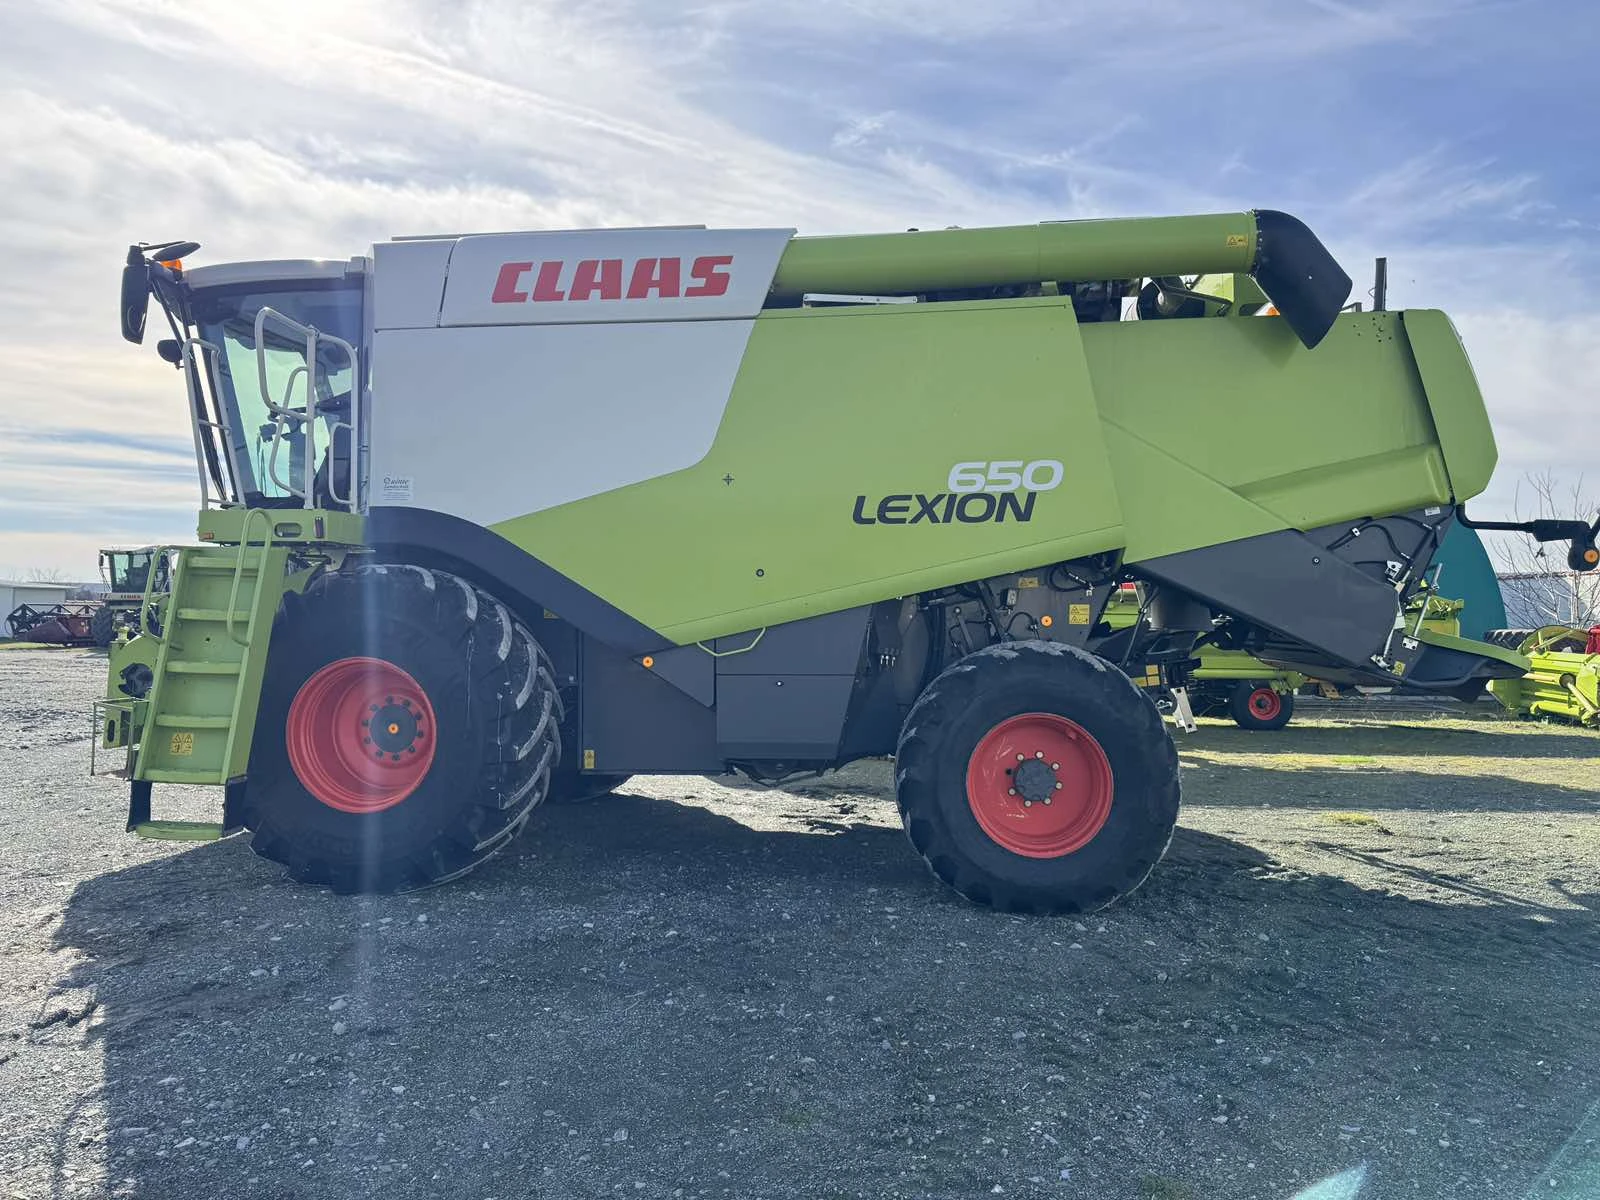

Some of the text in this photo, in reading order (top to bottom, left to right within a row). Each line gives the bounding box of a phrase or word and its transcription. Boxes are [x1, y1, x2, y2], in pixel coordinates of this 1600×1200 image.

[491, 255, 734, 303] CLAAS
[948, 459, 1064, 493] 650
[852, 491, 1037, 525] LEXION
